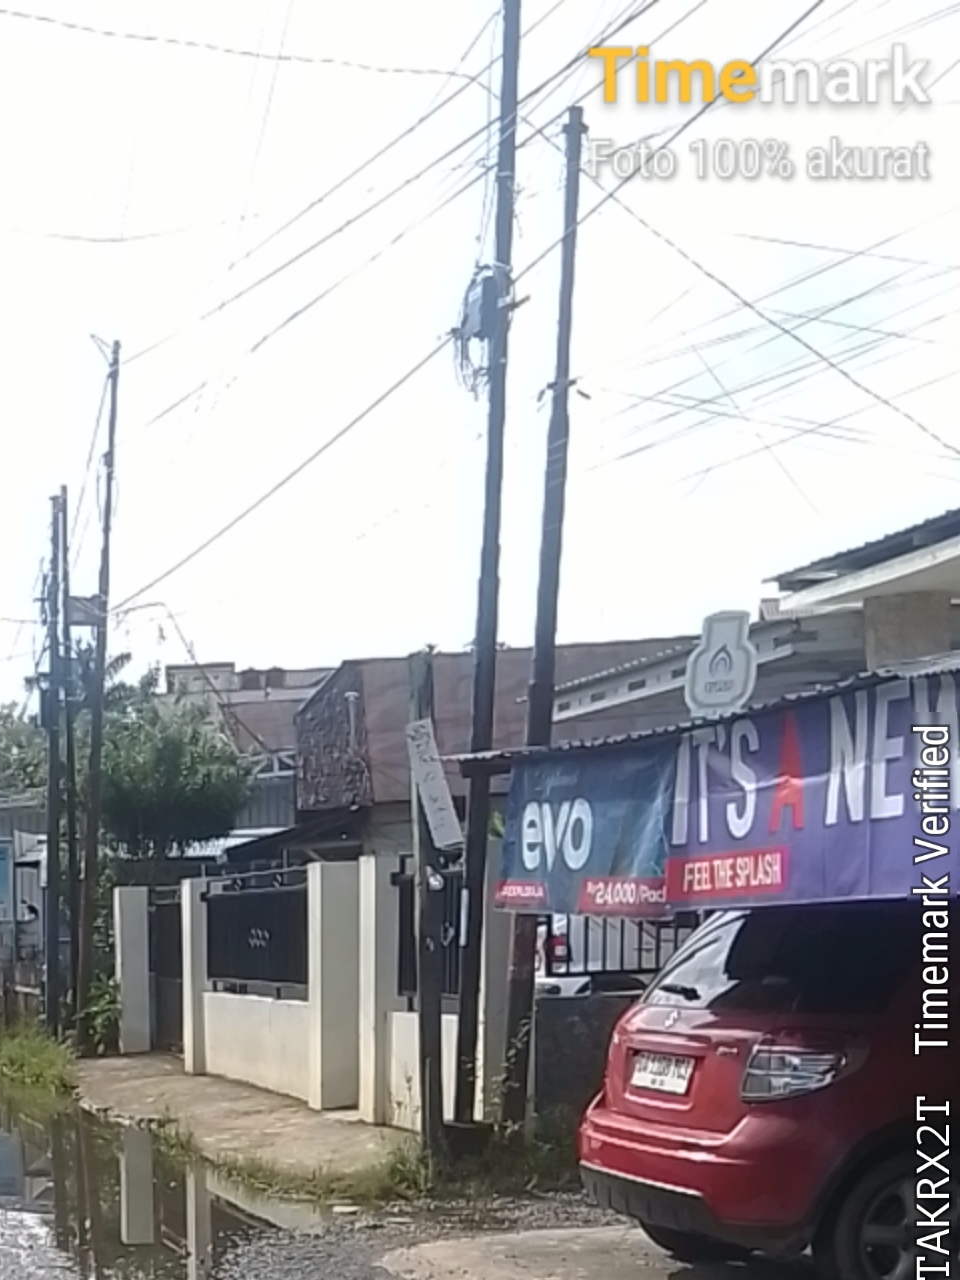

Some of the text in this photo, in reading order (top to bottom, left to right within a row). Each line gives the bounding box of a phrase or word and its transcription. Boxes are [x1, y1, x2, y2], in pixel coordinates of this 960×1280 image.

[672, 716, 760, 846] IT'S
[768, 708, 805, 833] A
[522, 797, 593, 873] evo
[683, 852, 782, 892] FEEL THE SPLASH
